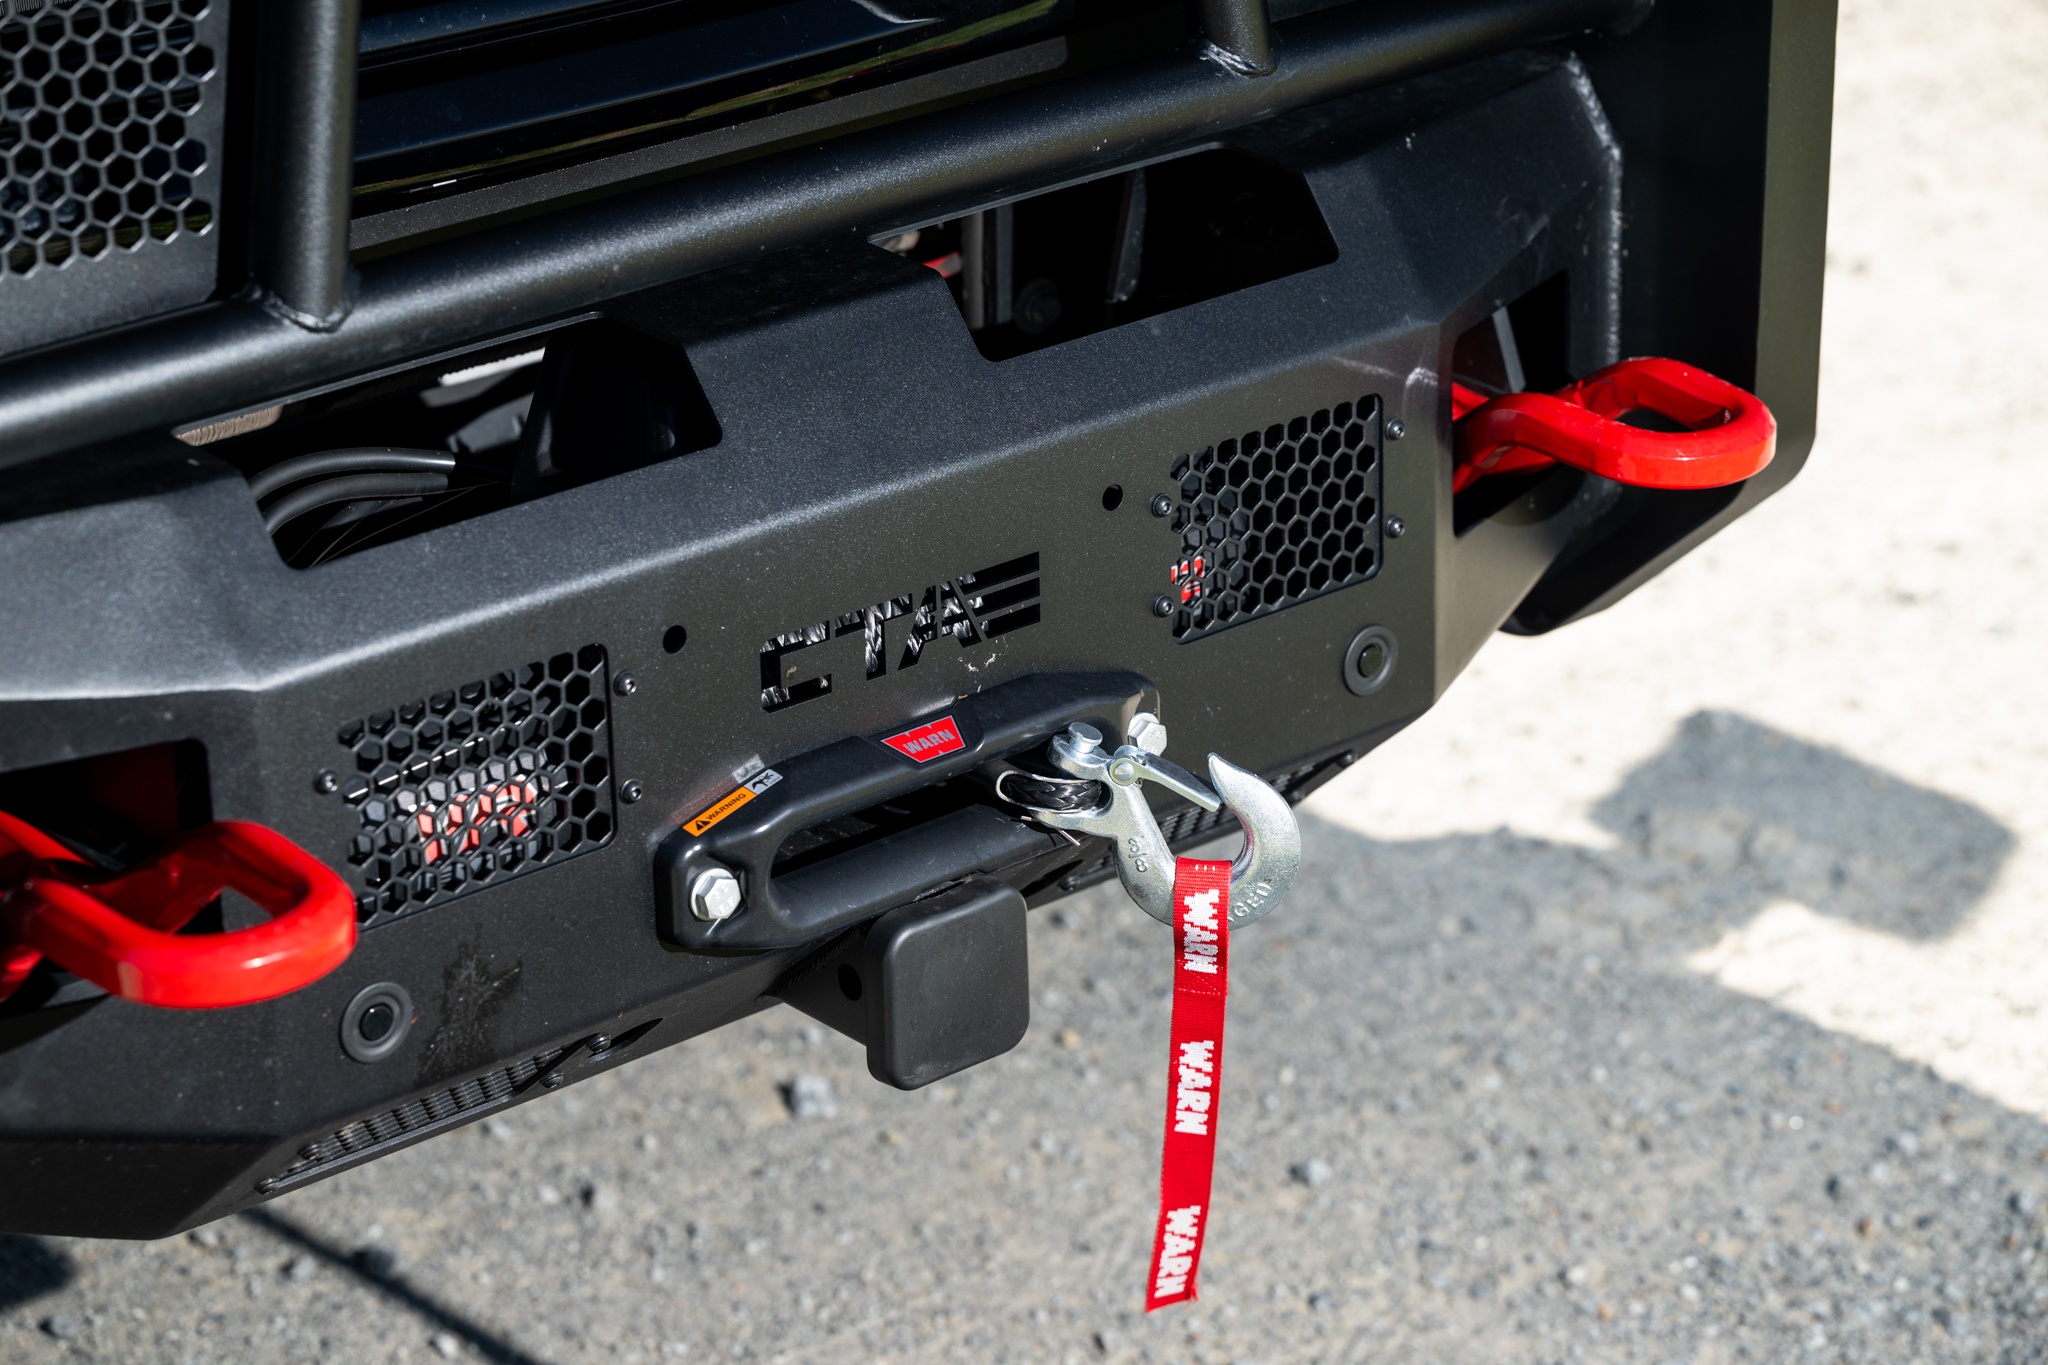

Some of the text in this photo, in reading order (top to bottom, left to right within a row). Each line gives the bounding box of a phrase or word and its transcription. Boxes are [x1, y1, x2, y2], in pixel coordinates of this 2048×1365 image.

[902, 729, 956, 754] WARN
[705, 792, 747, 821] WARNING
[1127, 837, 1149, 873] 3/8
[1227, 882, 1273, 922] GED
[1183, 889, 1220, 974] WARN
[1174, 1040, 1215, 1136] WARN
[1154, 1205, 1201, 1299] WARN
